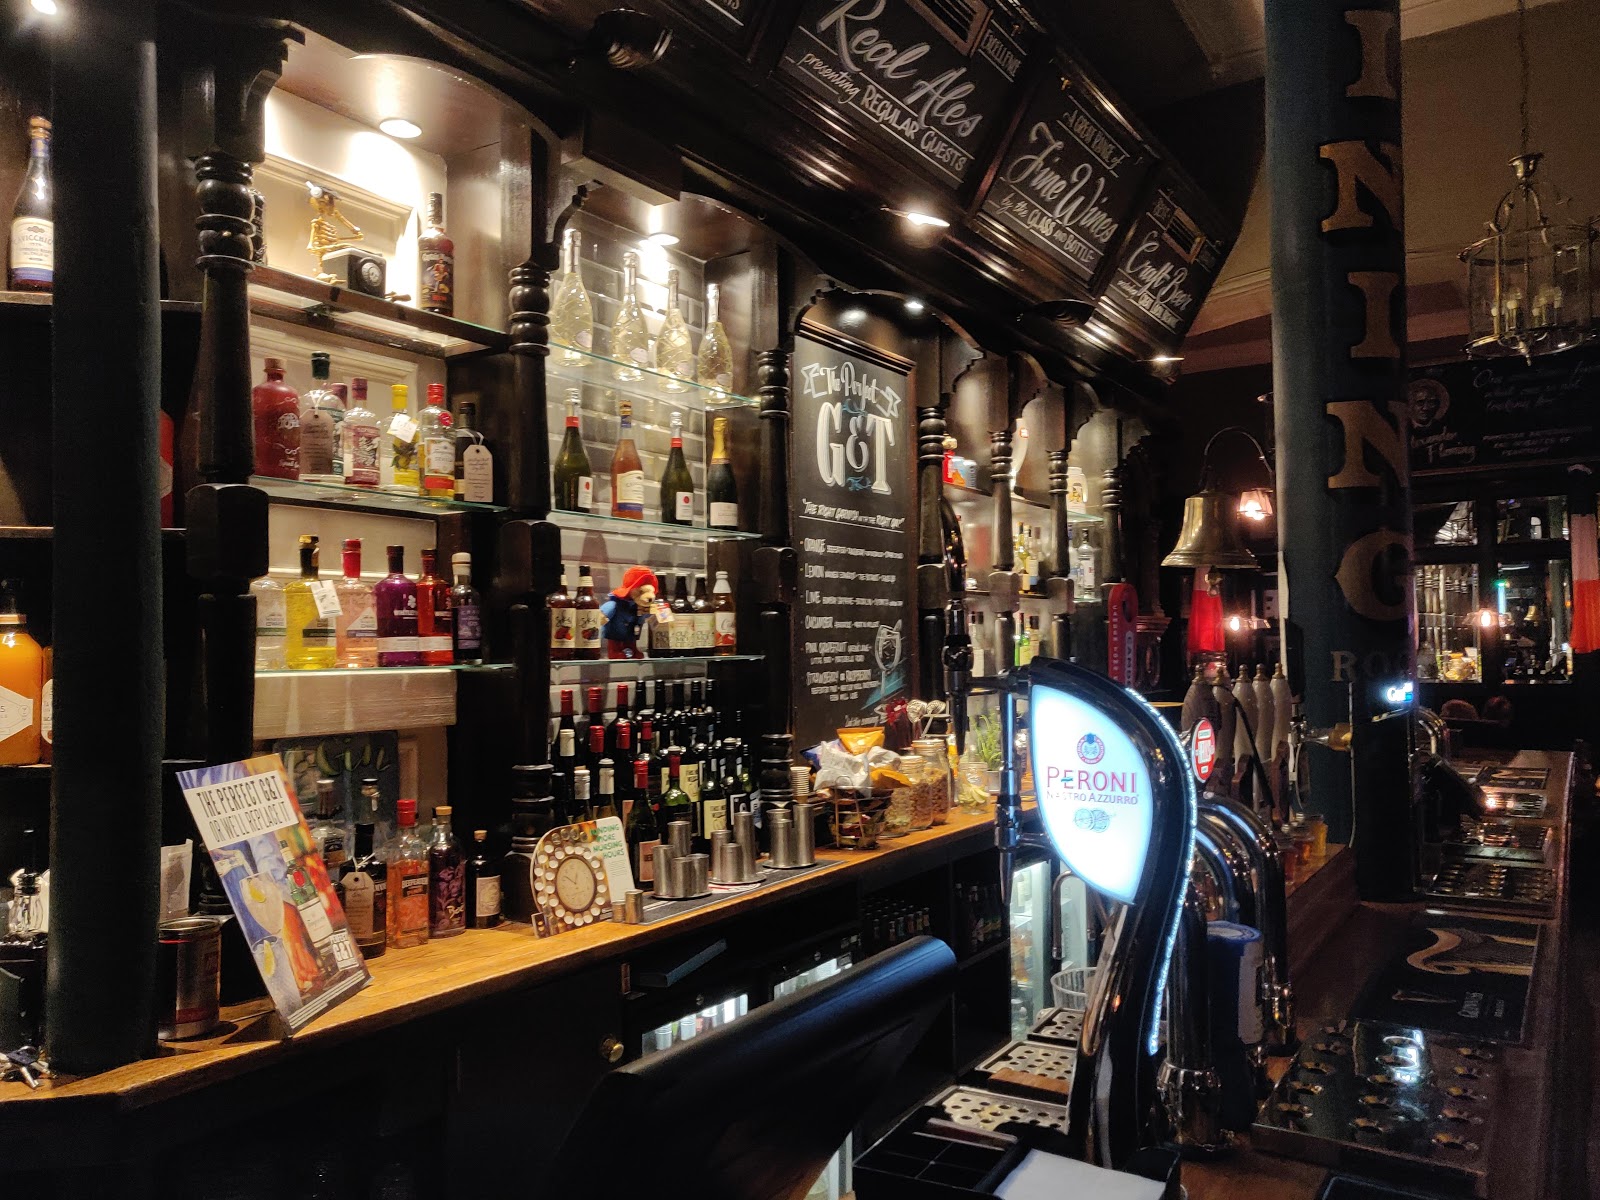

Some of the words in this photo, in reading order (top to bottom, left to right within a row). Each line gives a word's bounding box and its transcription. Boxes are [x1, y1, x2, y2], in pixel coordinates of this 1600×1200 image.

[816, 0, 931, 79] Real
[903, 66, 984, 138] Ales
[797, 52, 862, 104] presenting
[860, 84, 921, 141] REGULAR
[920, 130, 969, 172] GUESTS
[1006, 121, 1068, 201] Fine
[1053, 163, 1119, 243] Wines
[996, 192, 1014, 215] by
[1012, 199, 1028, 219] the
[1026, 207, 1055, 238] GLASS
[1062, 233, 1096, 264] BOTTLE
[1115, 230, 1175, 298] Craft
[1156, 266, 1194, 312] Beer
[820, 365, 842, 395] The
[815, 401, 897, 496] G&T
[196, 789, 222, 818] THE
[215, 780, 263, 814] PERFECT
[258, 775, 283, 801] G&T
[1046, 766, 1138, 793] PERONI
[1046, 790, 1087, 802] NASTRO
[1088, 792, 1138, 805] AZZURRO
[208, 819, 227, 843] OR
[219, 813, 251, 840] WE'LL
[244, 803, 283, 833] REPLACE
[277, 800, 291, 823] IT
[602, 848, 625, 860] HOURS
[332, 940, 354, 963] G&T
